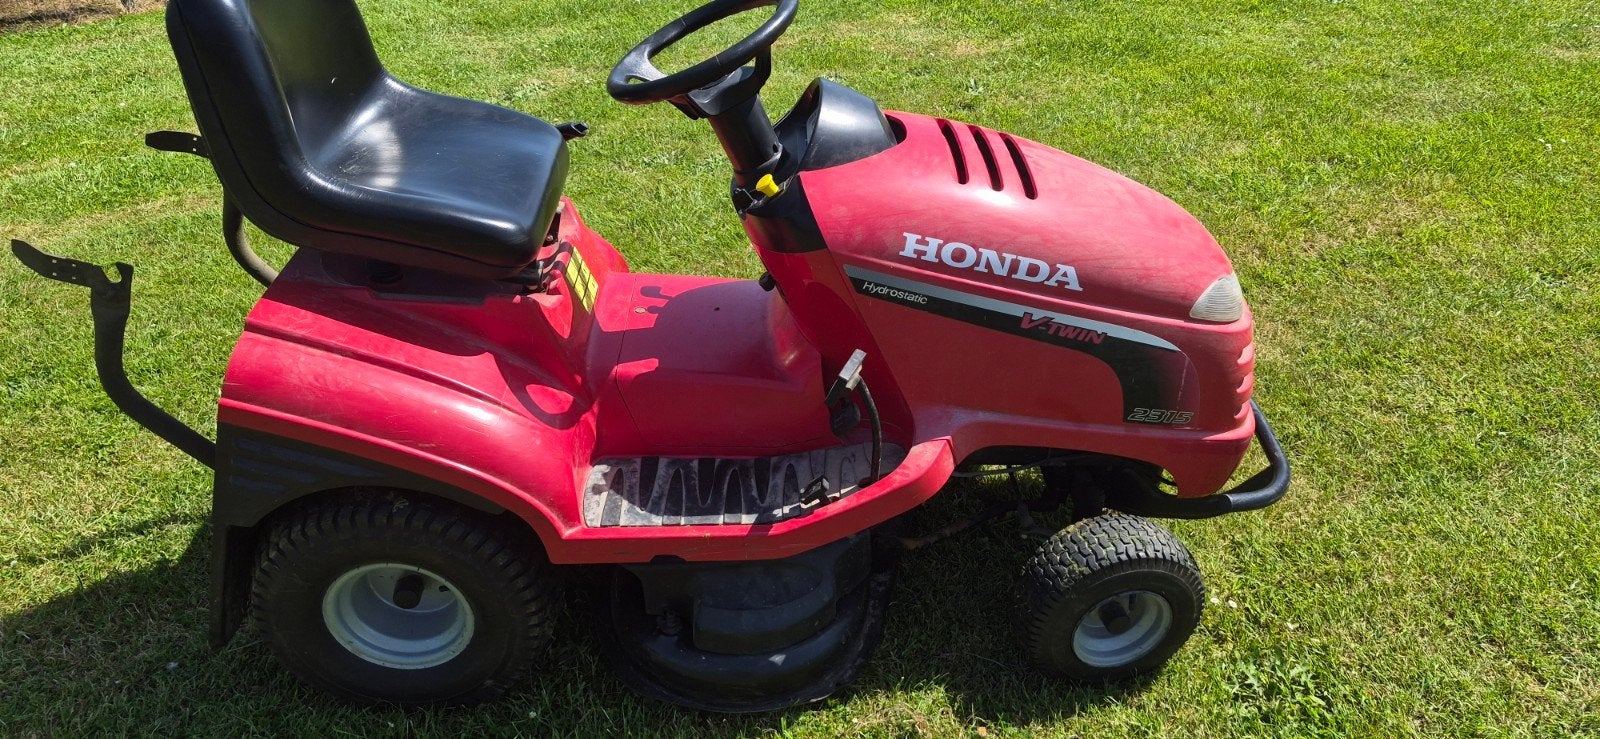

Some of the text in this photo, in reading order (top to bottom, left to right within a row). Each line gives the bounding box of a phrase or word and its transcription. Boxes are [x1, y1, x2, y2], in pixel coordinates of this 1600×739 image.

[899, 232, 1083, 291] HONDA
[862, 281, 928, 304] Hydrostatic
[1020, 312, 1107, 344] V-TWIN
[1127, 407, 1194, 424] 2315
